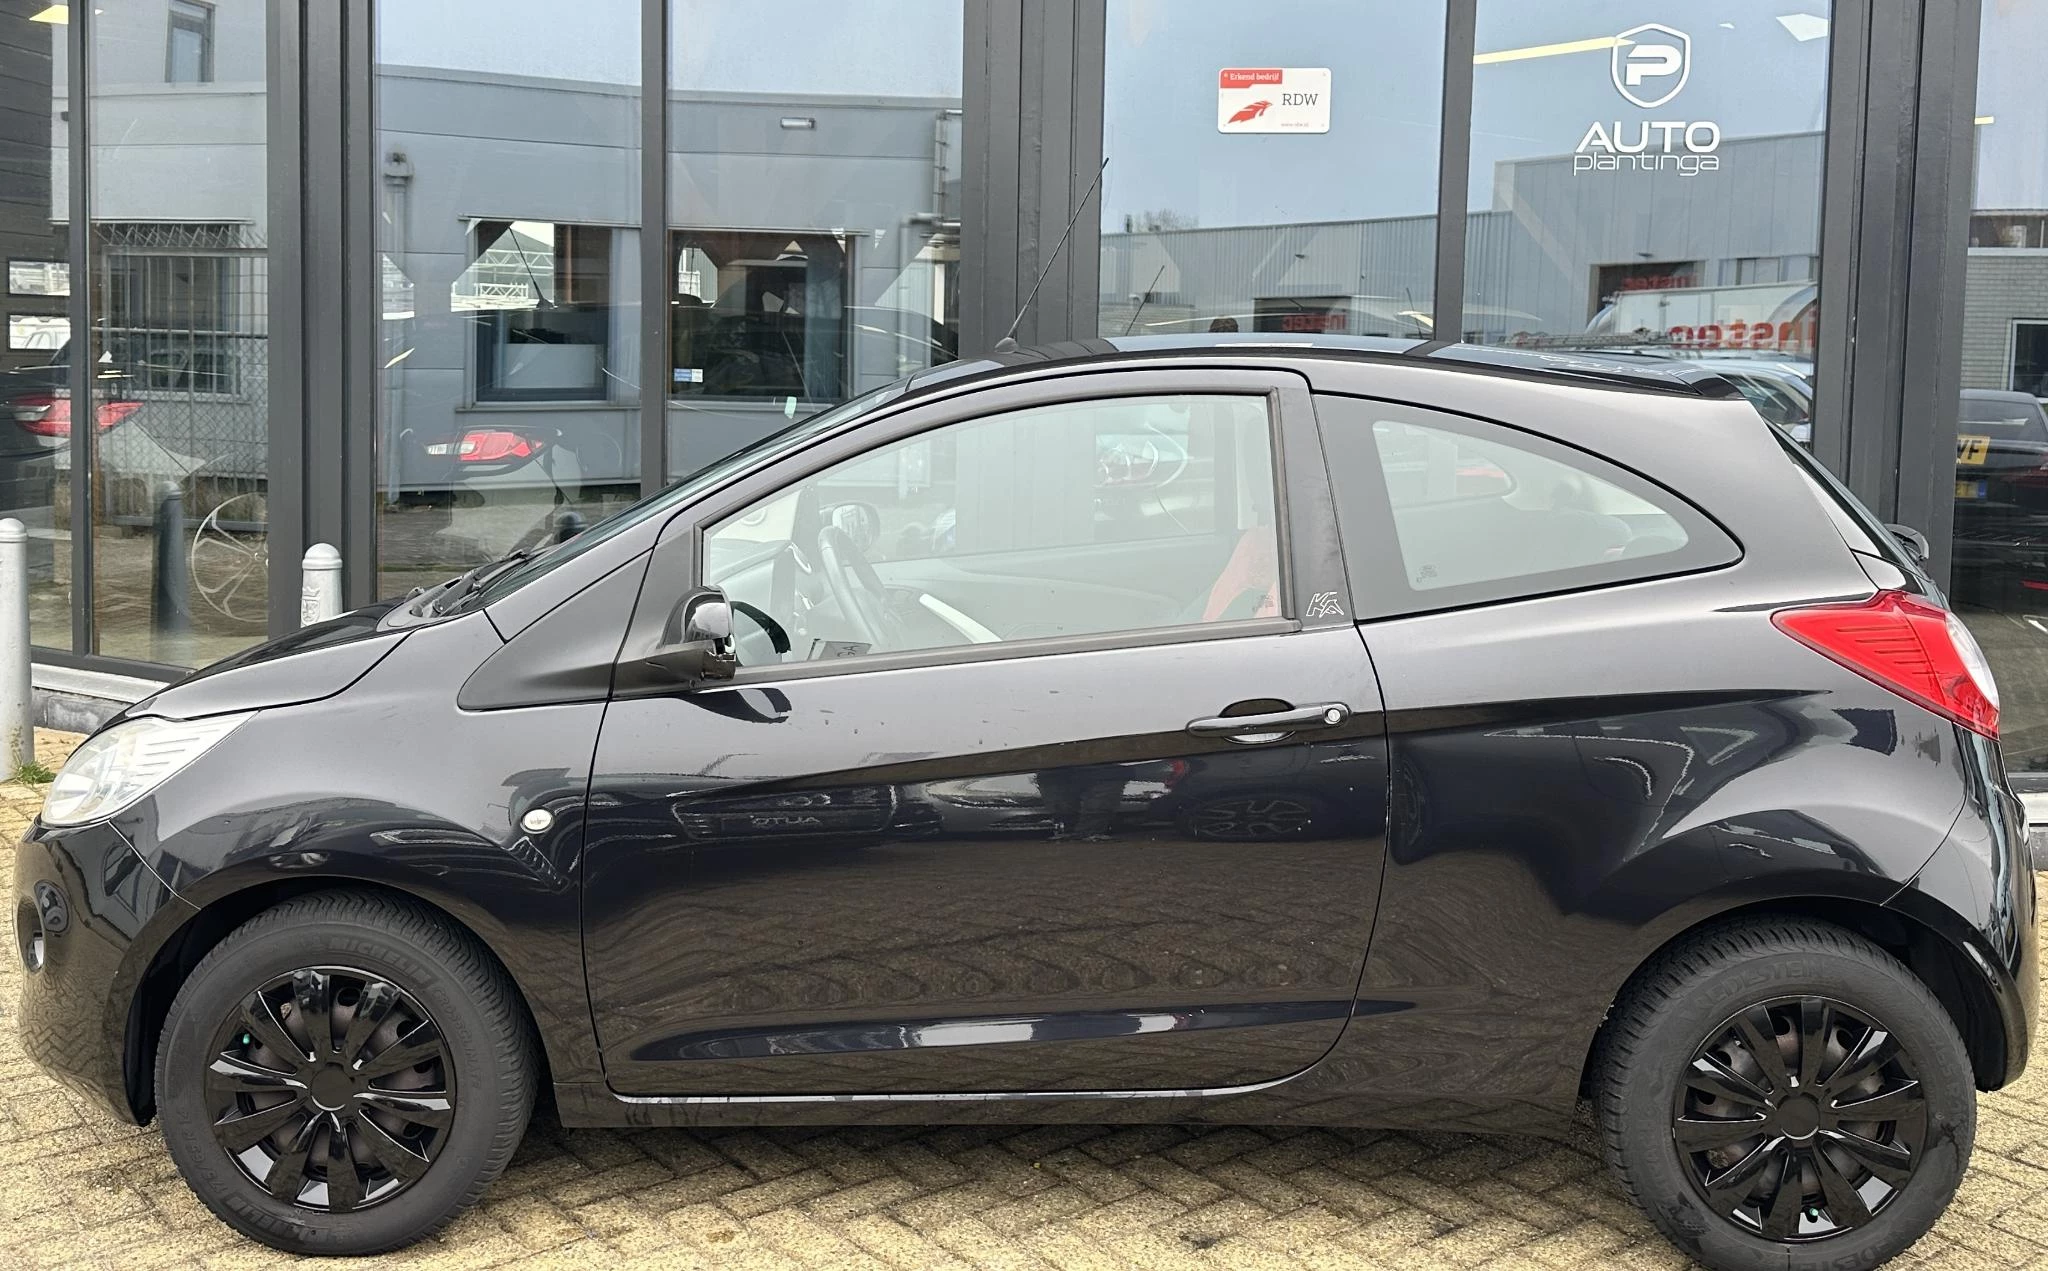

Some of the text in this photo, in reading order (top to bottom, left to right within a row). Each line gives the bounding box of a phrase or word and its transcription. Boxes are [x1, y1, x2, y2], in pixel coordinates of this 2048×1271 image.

[1229, 73, 1280, 83] Erkend bedrijf
[1626, 44, 1683, 86] P
[1281, 93, 1319, 106] RDW
[1576, 121, 1721, 154] AUTO
[1573, 152, 1720, 177] plantinga
[328, 935, 432, 985] MICHELIN
